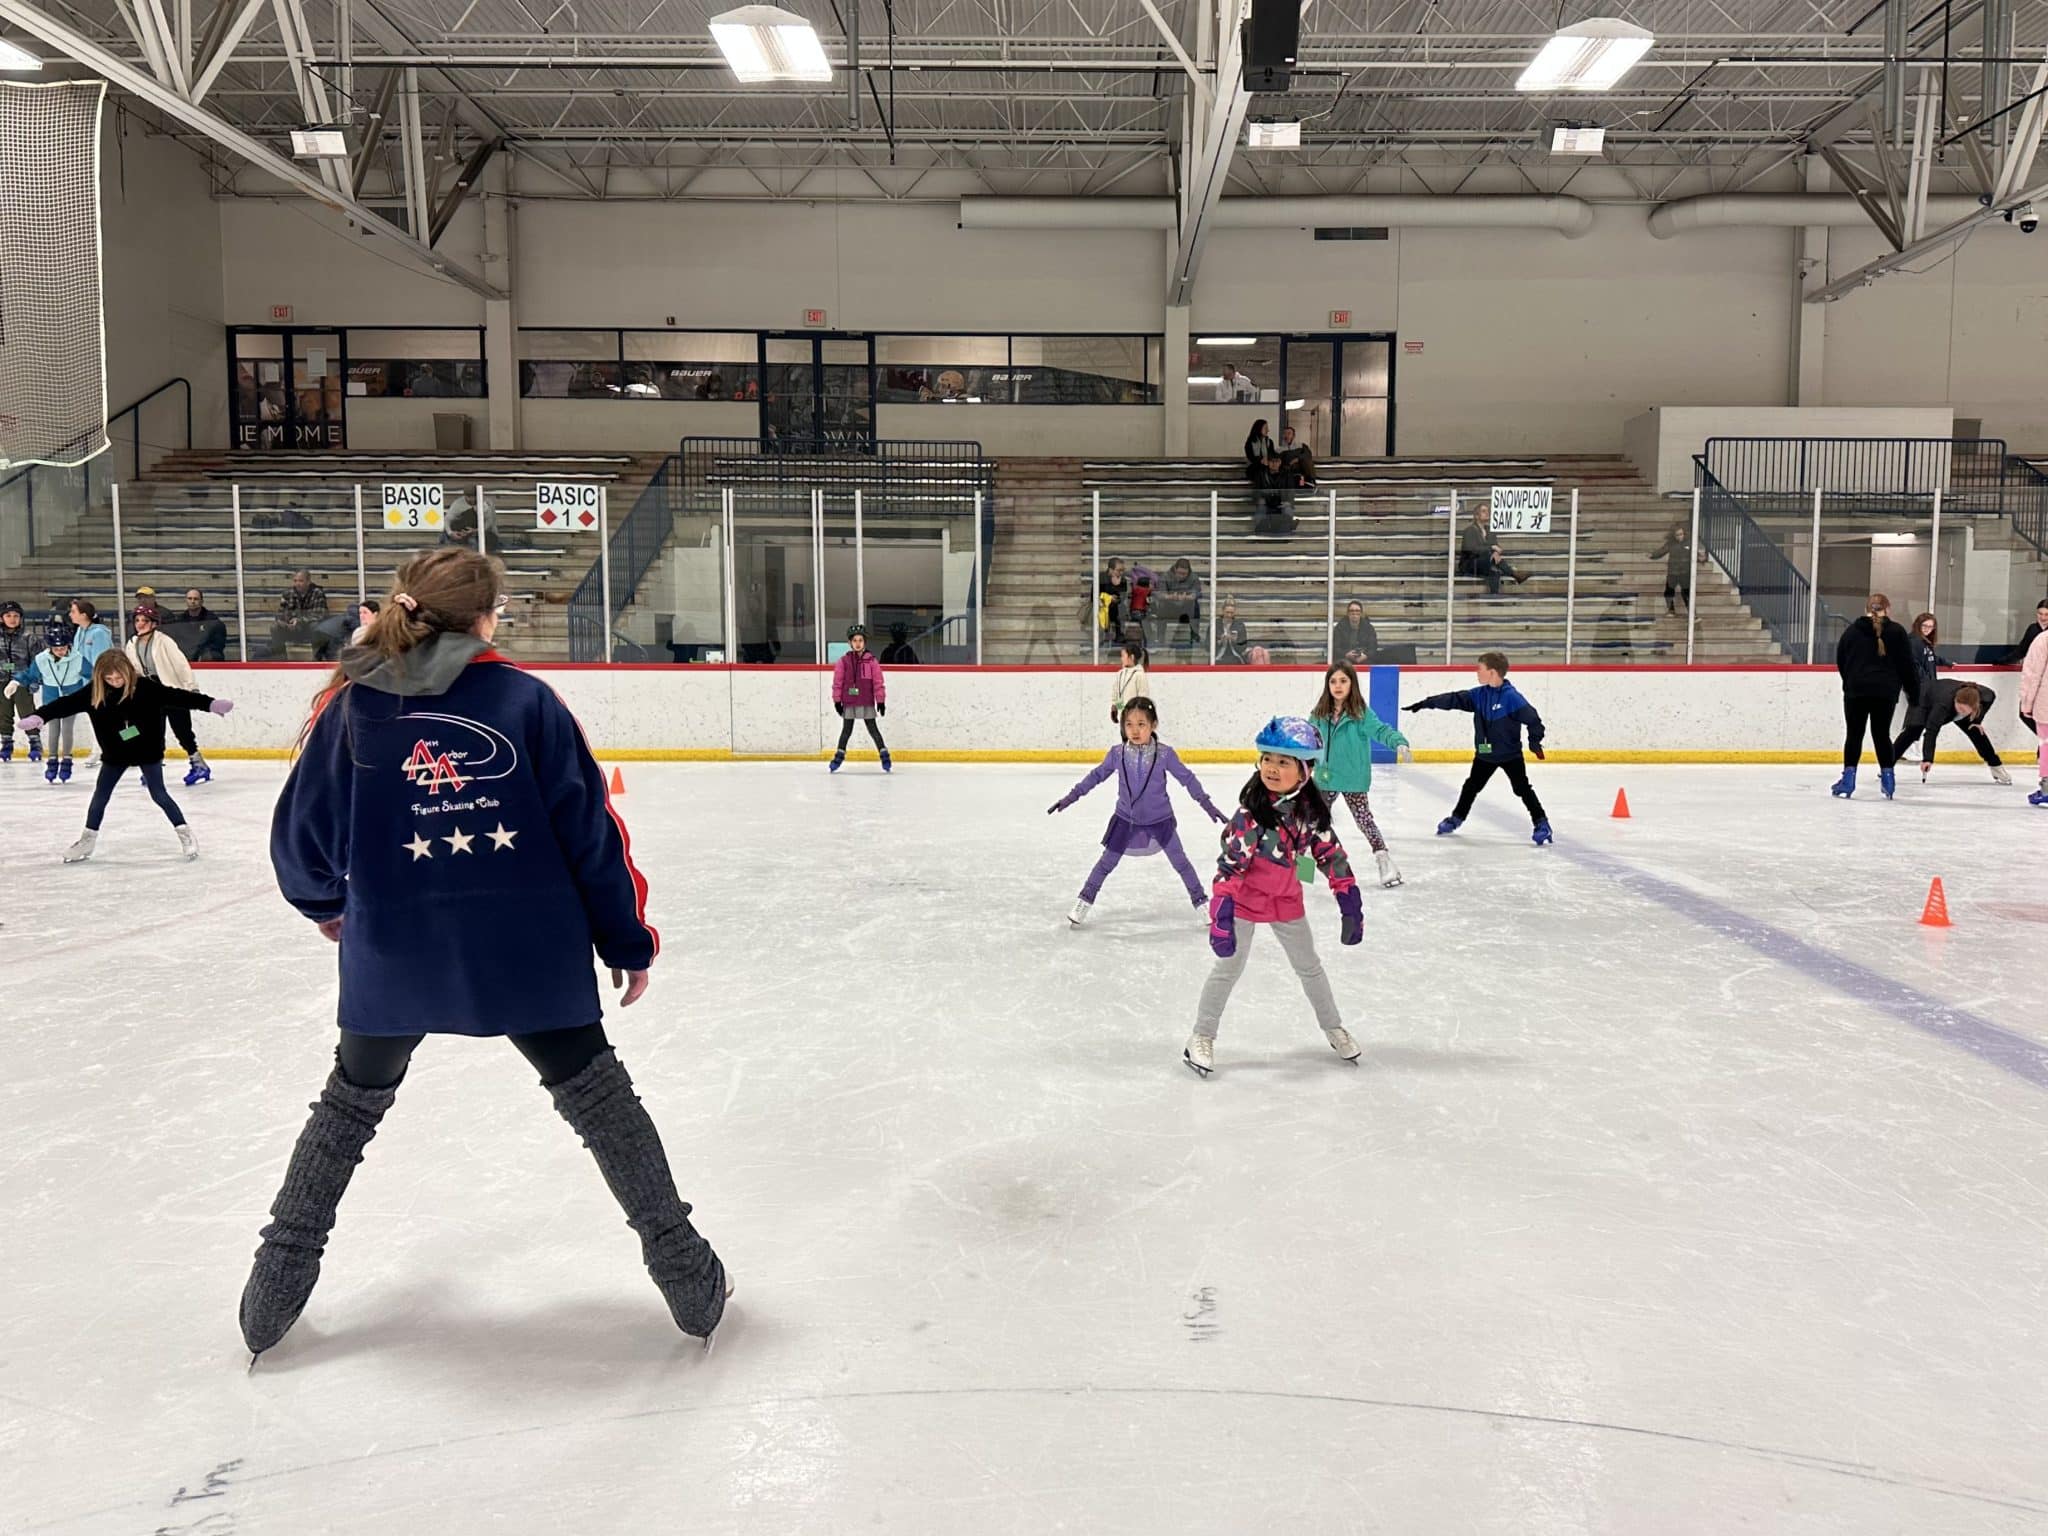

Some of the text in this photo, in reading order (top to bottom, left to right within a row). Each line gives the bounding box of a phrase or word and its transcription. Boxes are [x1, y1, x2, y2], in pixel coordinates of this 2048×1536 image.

[273, 306, 289, 318] EXIT
[807, 311, 823, 323] EXIT
[1334, 311, 1349, 324] EXIT
[670, 369, 713, 377] BAUER
[384, 486, 442, 506] BASIC
[538, 485, 597, 507] BASIC
[1493, 490, 1550, 509] SNOWPLOW
[408, 508, 419, 527] 3
[562, 508, 571, 526] 1
[1492, 510, 1523, 530] SAM 2
[410, 796, 501, 816] Figure Skating Club
